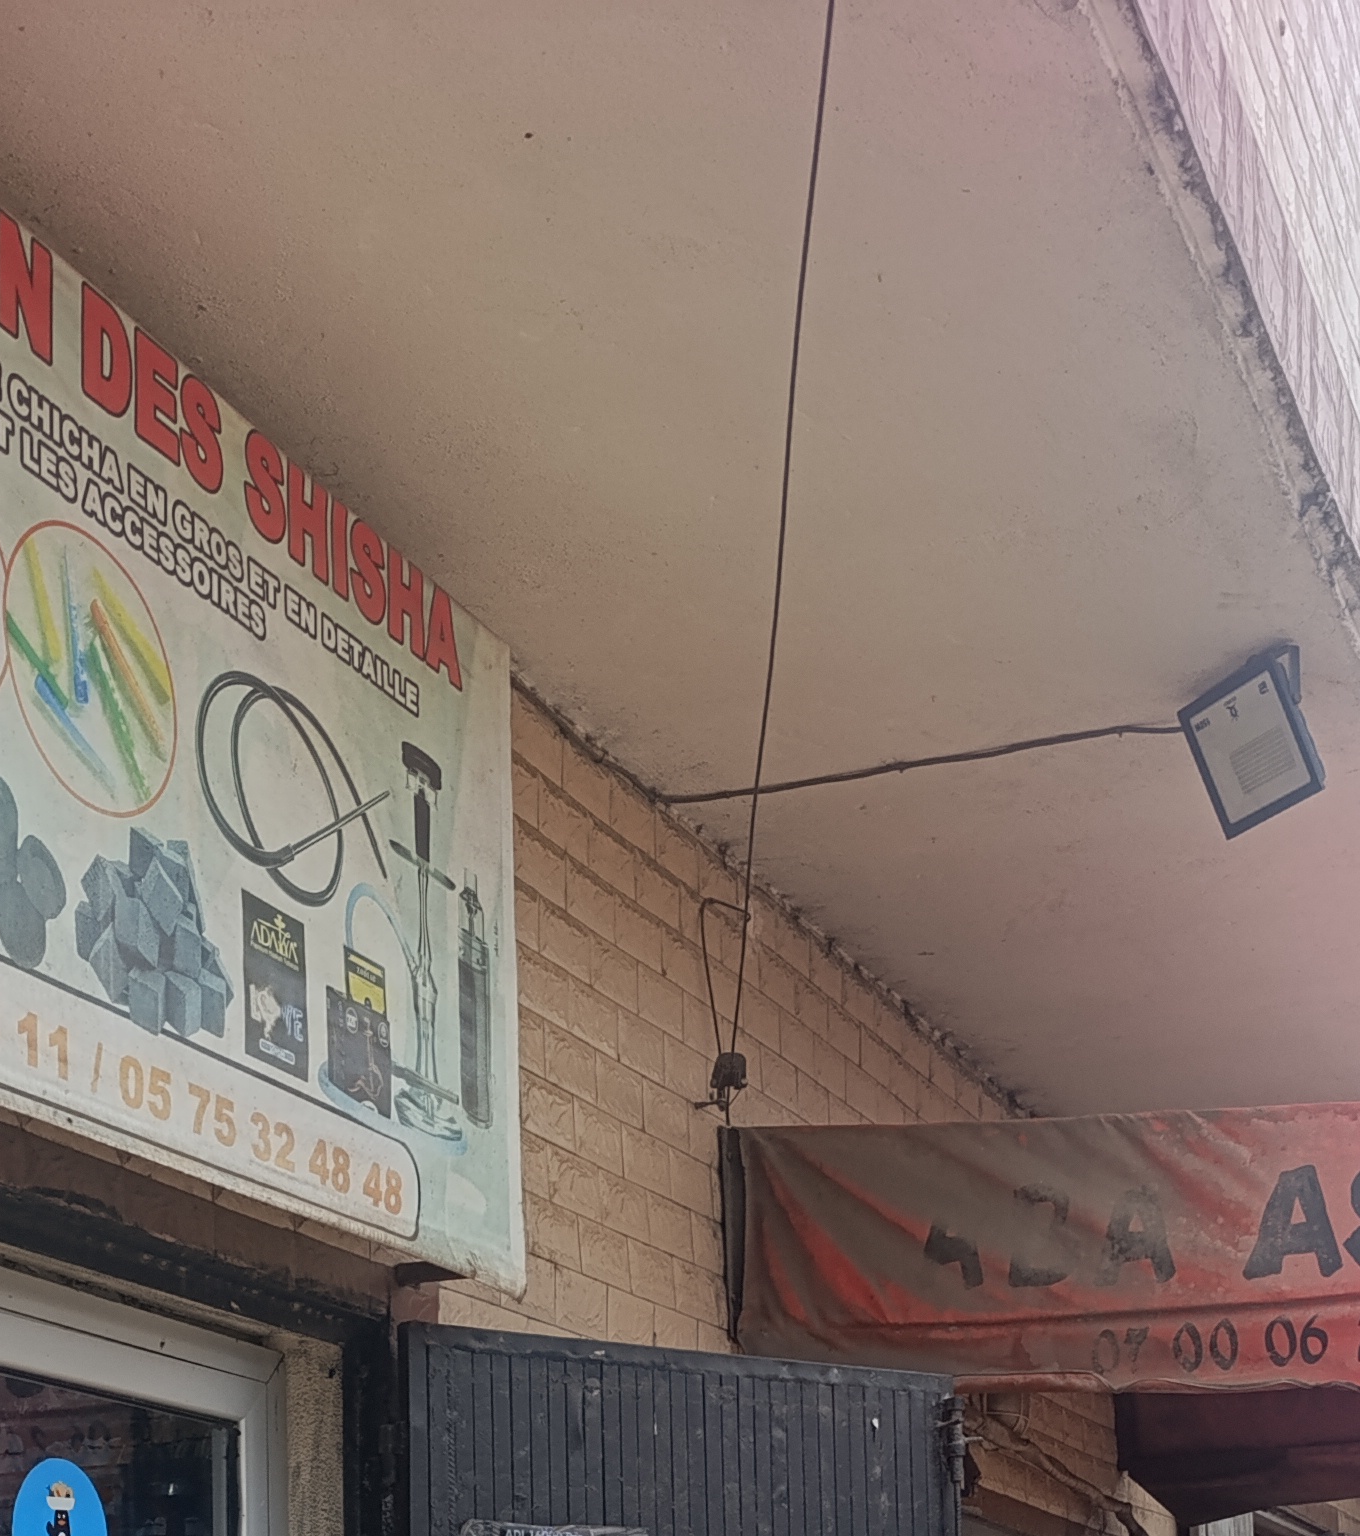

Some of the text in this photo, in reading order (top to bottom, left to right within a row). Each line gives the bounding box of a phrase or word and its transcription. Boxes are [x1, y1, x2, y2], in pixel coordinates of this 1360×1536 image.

[7, 372, 123, 493] CHICHA
[127, 461, 168, 526] EN
[172, 498, 244, 581] GROS
[248, 554, 280, 608] ET
[283, 582, 317, 639] EN
[322, 612, 419, 717] DETAILLE
[19, 417, 77, 502] LES
[82, 478, 266, 640] ACCESSOIRES
[81, 281, 224, 493] DES
[243, 429, 463, 691] SHISHA
[17, 1010, 70, 1084] 11
[117, 1055, 173, 1121] 05
[188, 1084, 237, 1148] 75
[250, 1110, 296, 1173] 32
[308, 1135, 351, 1195] 48
[362, 1160, 404, 1217] 48
[1172, 1318, 1239, 1373] 00
[1264, 1313, 1329, 1367] 06
